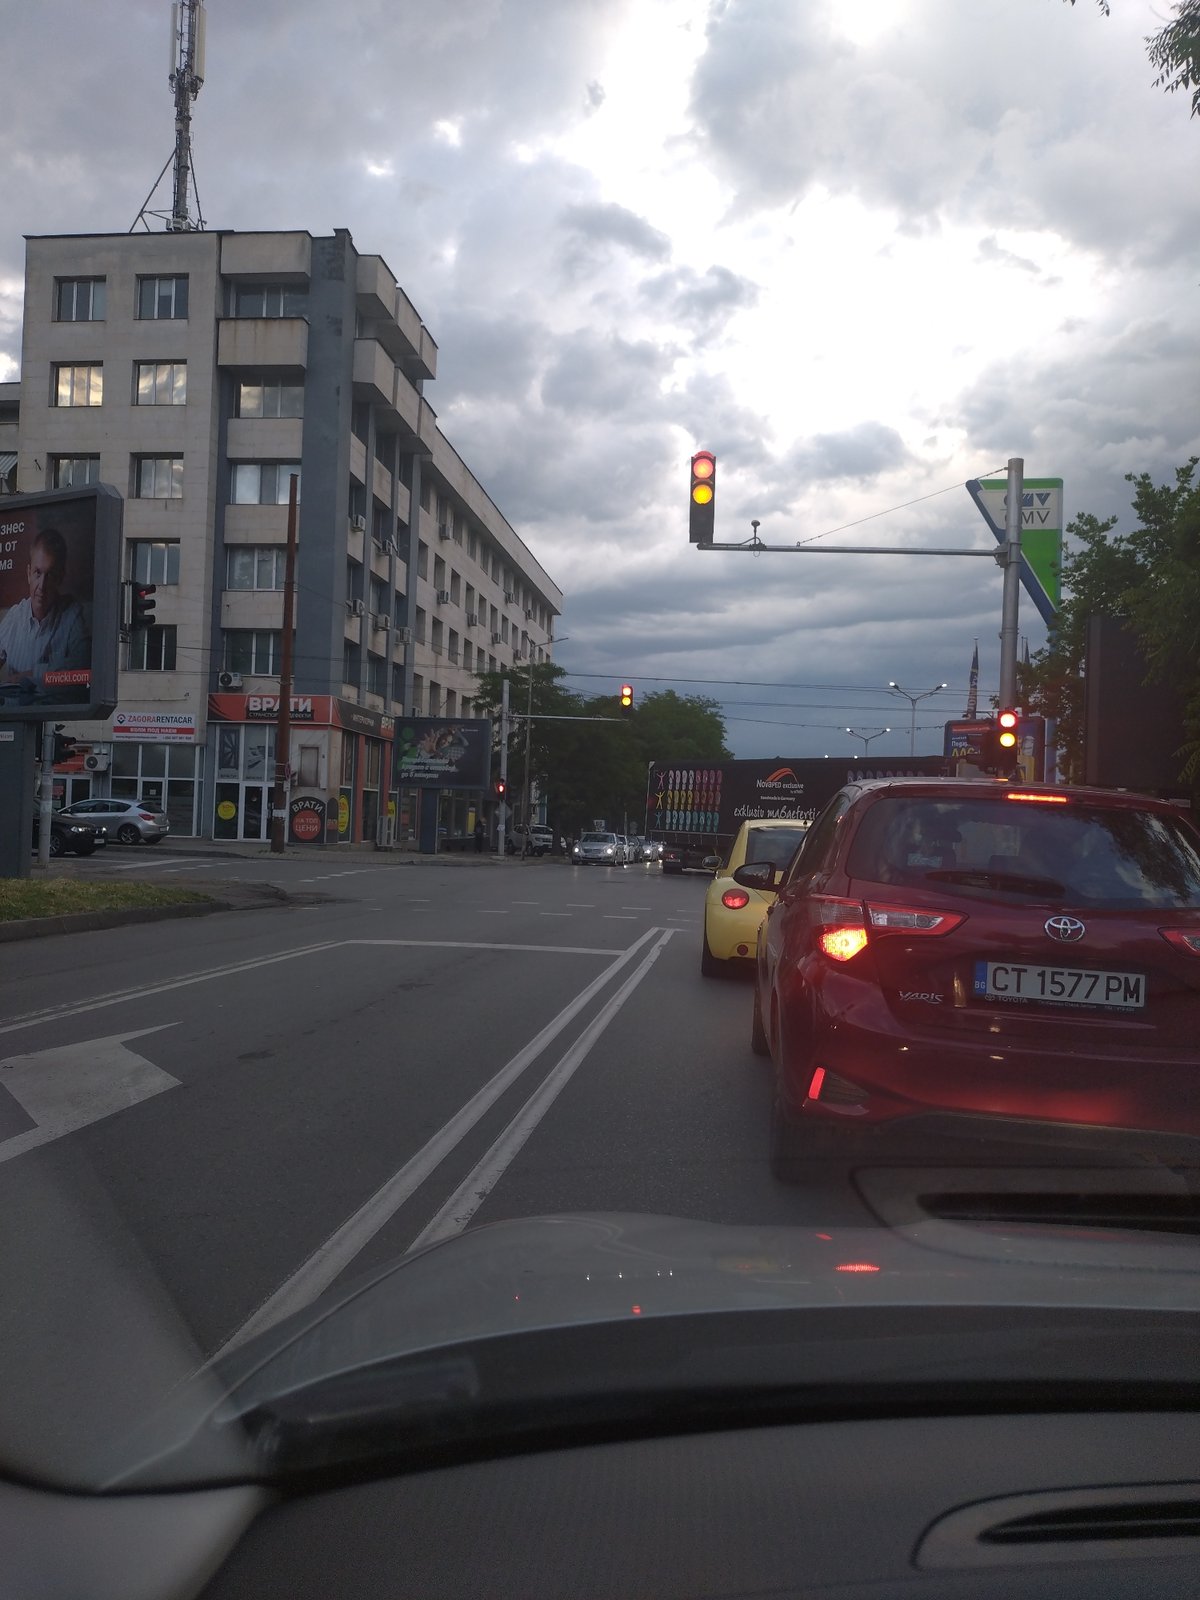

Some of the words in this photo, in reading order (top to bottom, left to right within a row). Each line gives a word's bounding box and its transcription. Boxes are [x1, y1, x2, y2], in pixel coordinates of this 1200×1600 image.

[1004, 511, 1050, 524] MV
[5, 540, 18, 552] от
[45, 672, 89, 685] krivicki.com
[291, 800, 324, 813] ВРАТИ
[733, 804, 765, 817] exklusiv
[295, 824, 319, 832] ЦЕНИ
[974, 980, 986, 989] BG
[992, 966, 1028, 993] CT
[1037, 969, 1100, 999] 1577
[1105, 975, 1141, 1003] PM
[997, 996, 1029, 1004] TOYOTA
